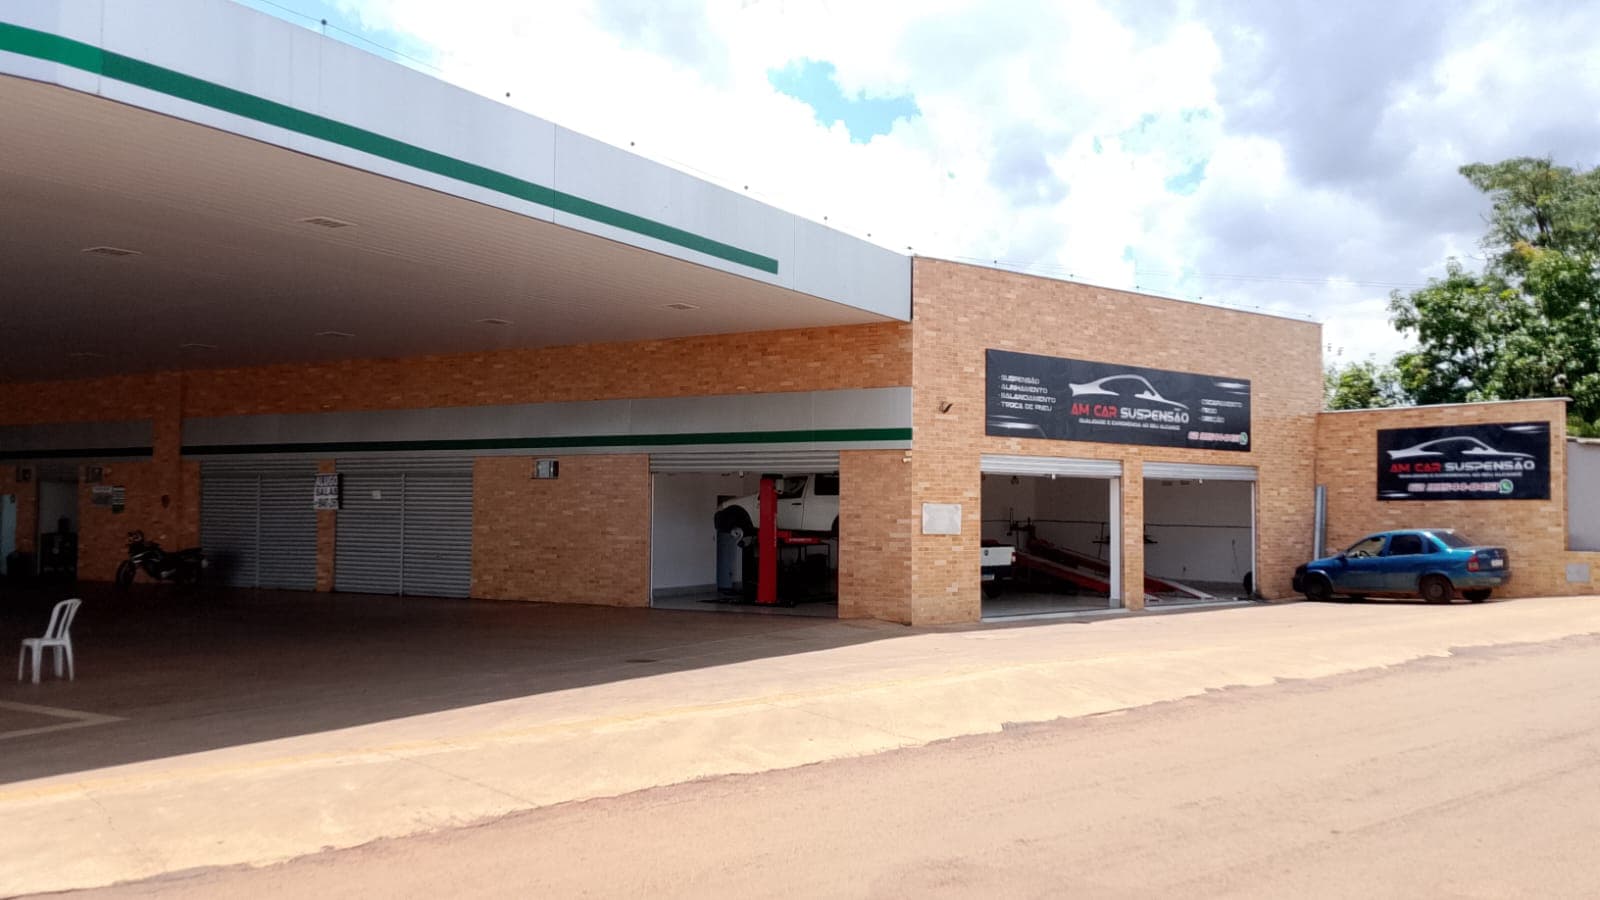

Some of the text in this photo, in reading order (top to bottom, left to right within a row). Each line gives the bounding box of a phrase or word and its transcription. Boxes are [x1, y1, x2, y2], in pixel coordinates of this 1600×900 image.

[1071, 403, 1090, 416] AM
[1093, 404, 1118, 418] CAR
[1120, 407, 1189, 424] SUSPENSÃO
[1390, 457, 1536, 473] AM CAR SUSPENSÃO
